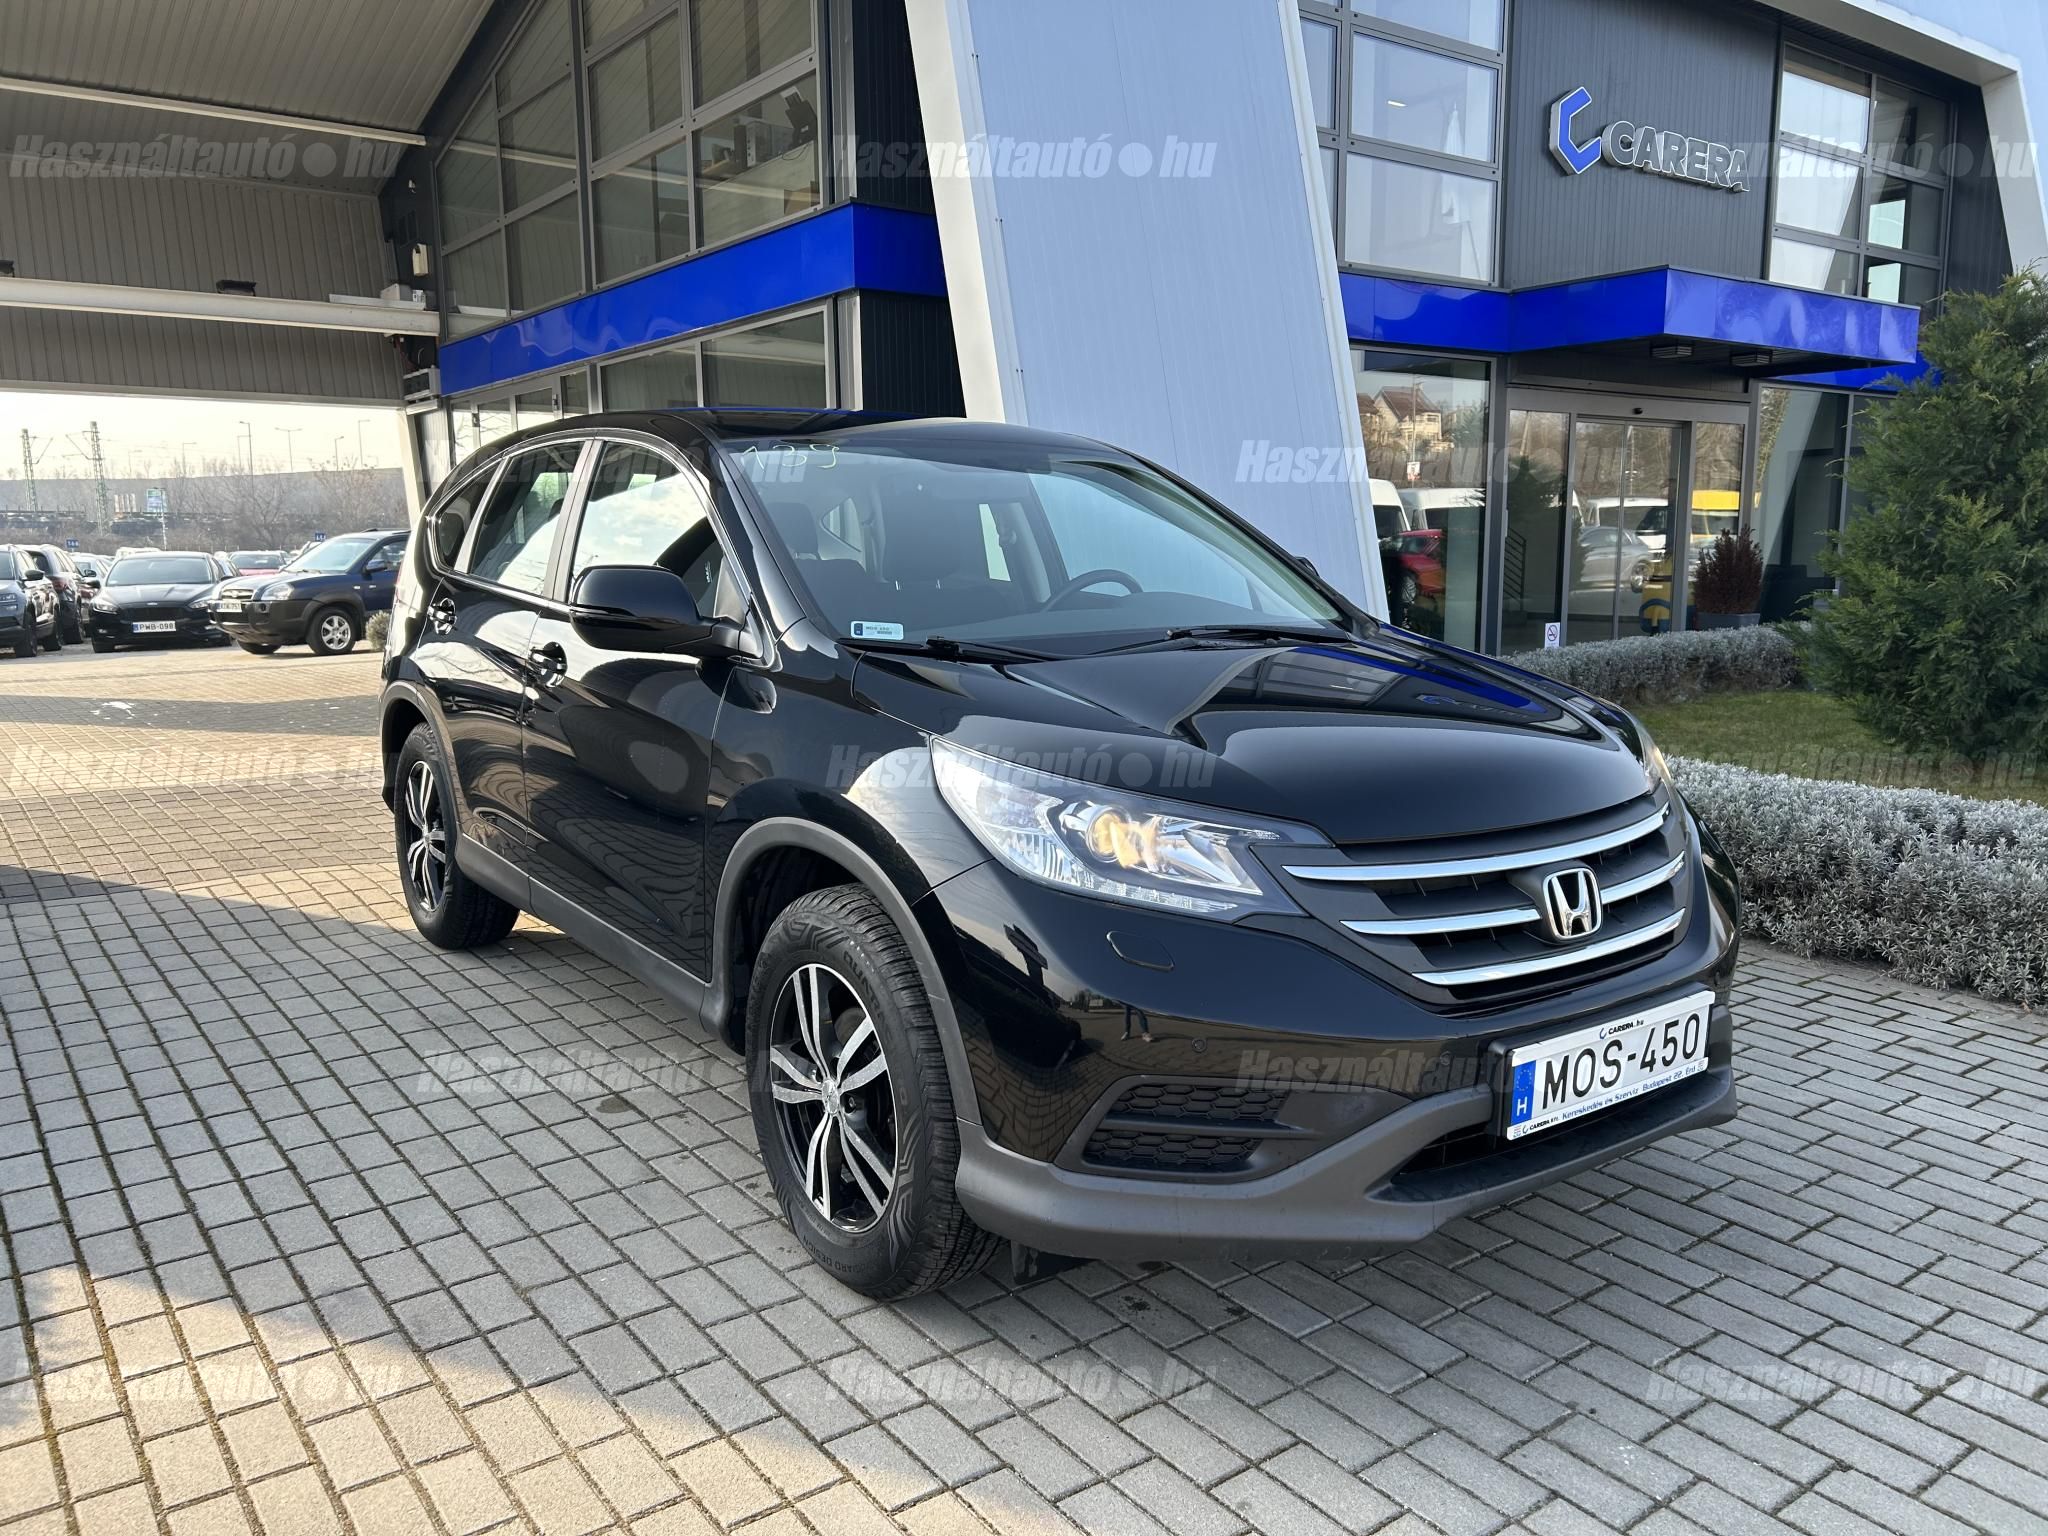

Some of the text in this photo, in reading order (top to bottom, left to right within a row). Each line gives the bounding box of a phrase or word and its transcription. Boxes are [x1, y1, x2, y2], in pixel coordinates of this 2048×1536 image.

[1602, 121, 1750, 193] CARERA
[139, 622, 175, 632] PWB-098
[1542, 1013, 1700, 1110] MOS-450
[1516, 1096, 1528, 1117] H
